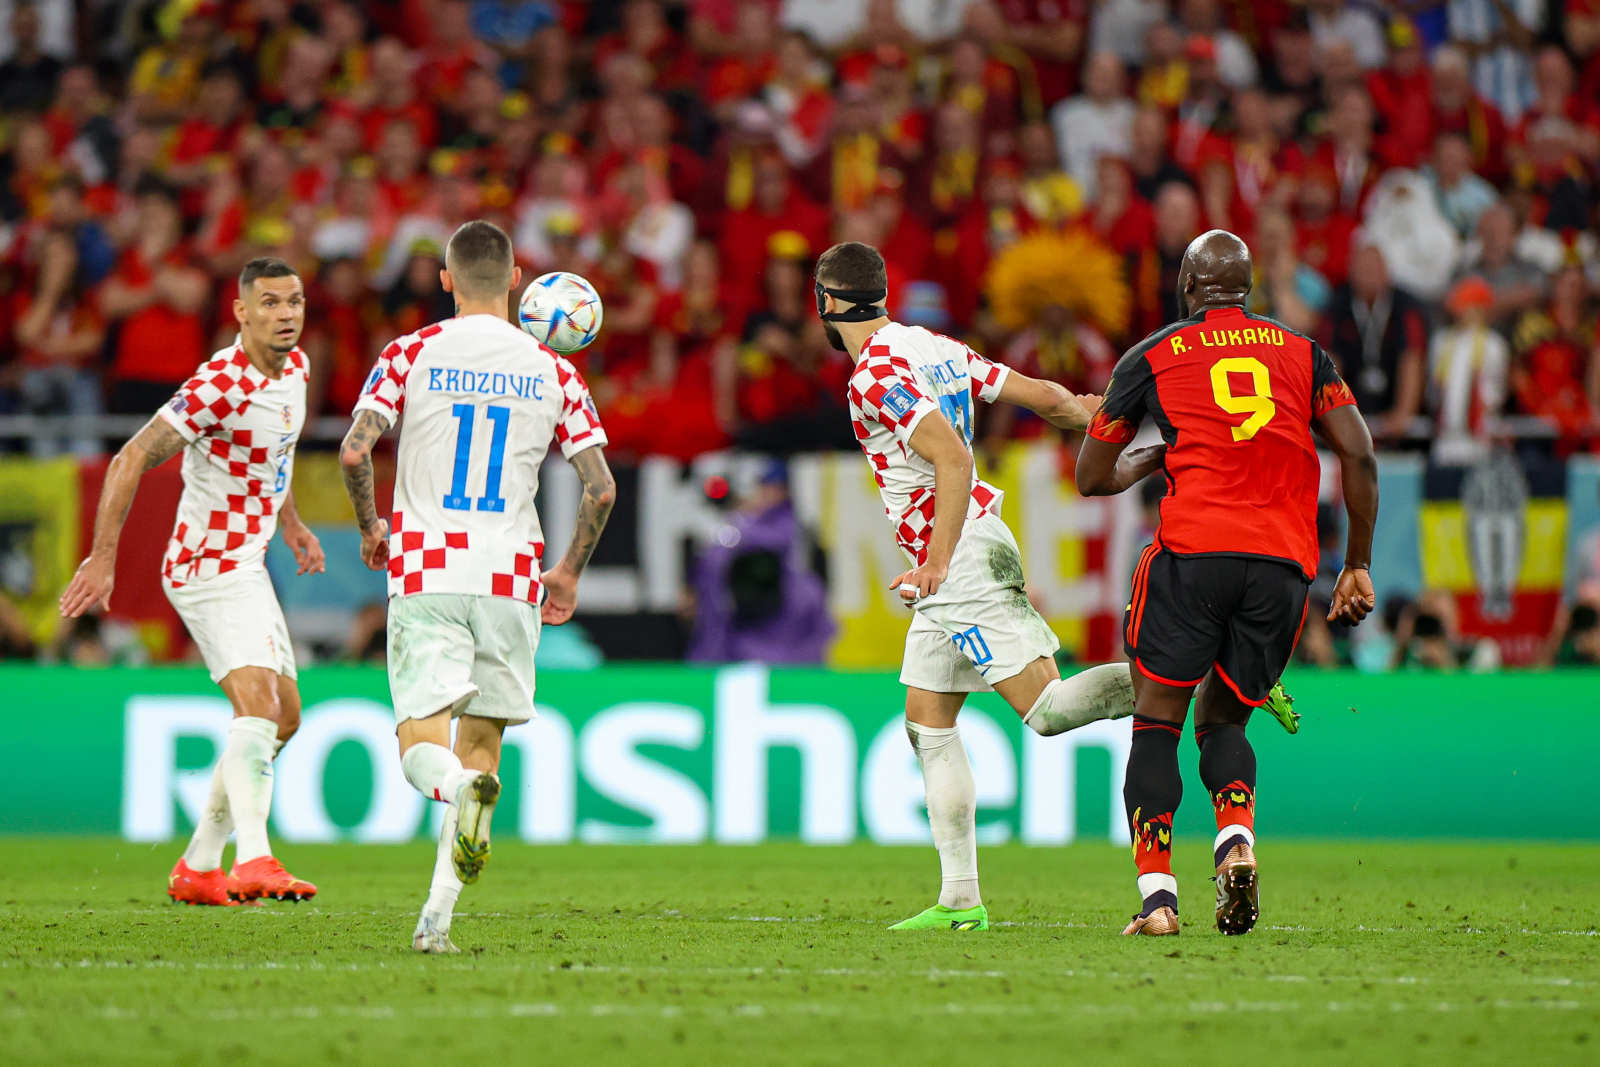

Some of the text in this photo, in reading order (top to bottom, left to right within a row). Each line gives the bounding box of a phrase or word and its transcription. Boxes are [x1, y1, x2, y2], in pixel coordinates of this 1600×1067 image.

[1170, 327, 1285, 356] R. LUKAKU
[428, 367, 545, 400] BROZOVIĆ
[1210, 357, 1276, 442] 9
[443, 403, 510, 512] 11
